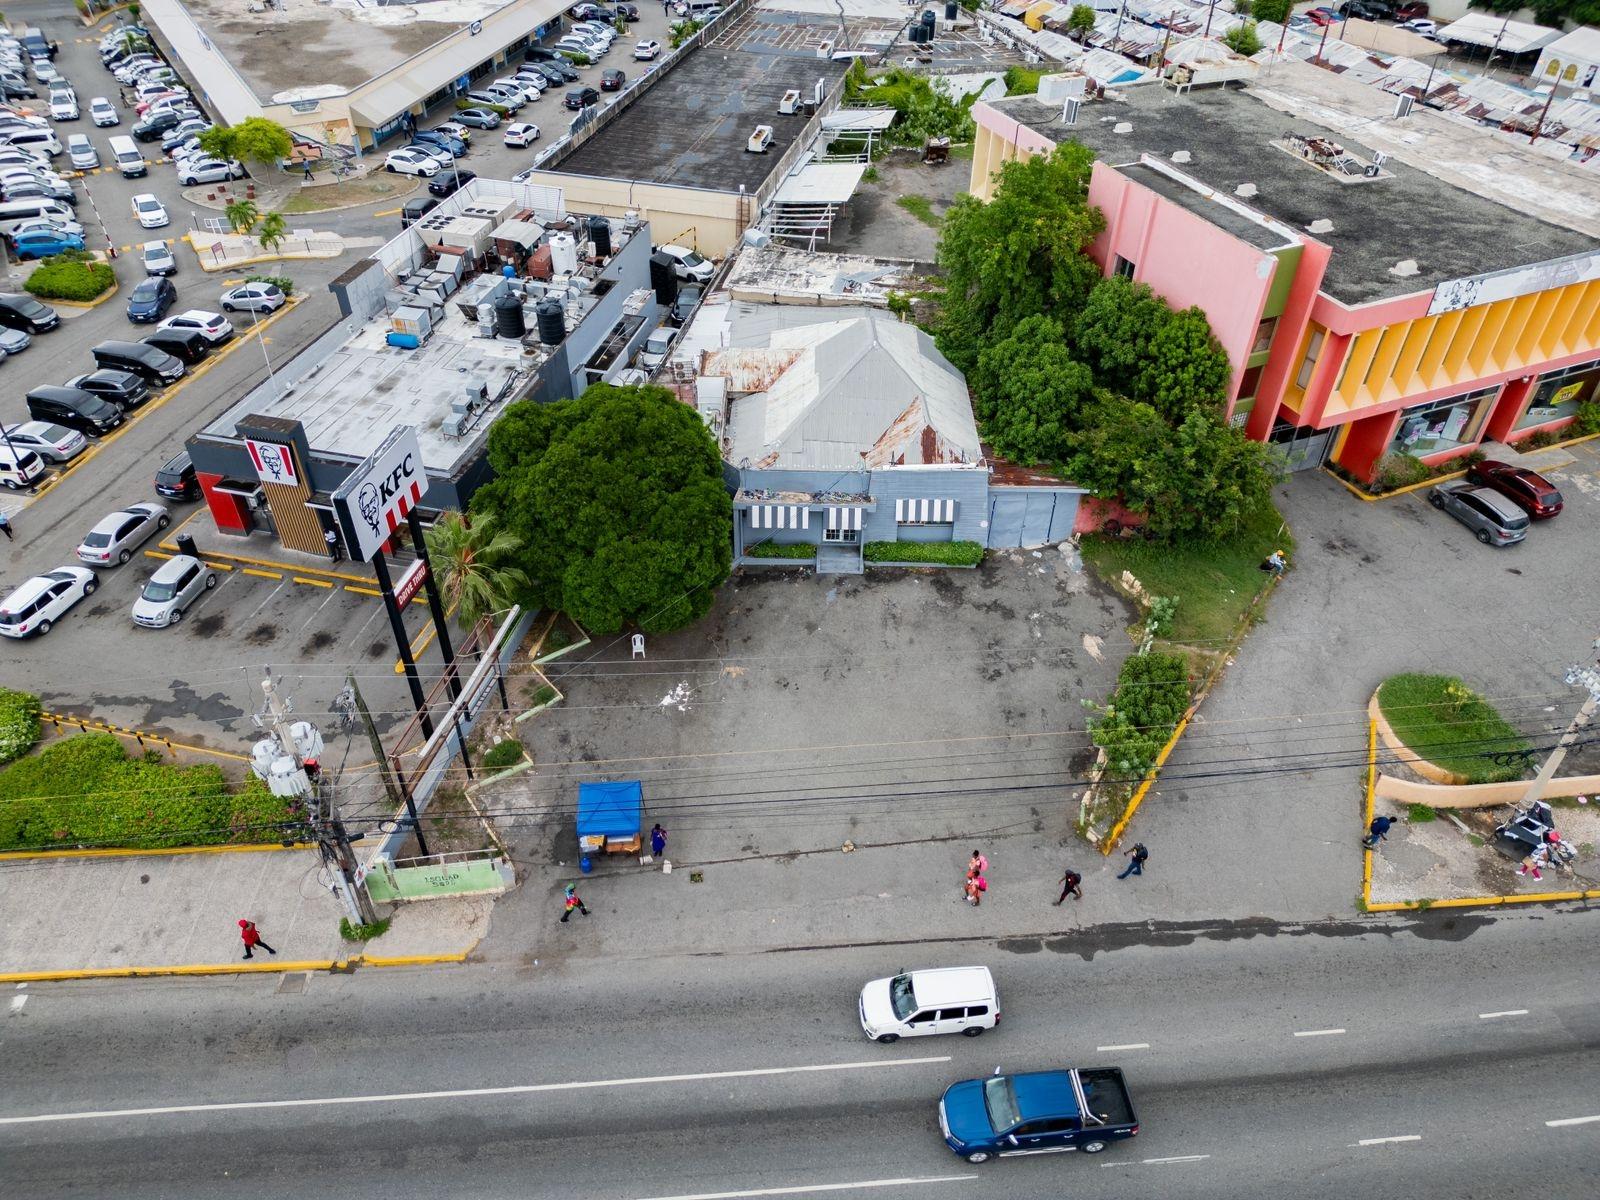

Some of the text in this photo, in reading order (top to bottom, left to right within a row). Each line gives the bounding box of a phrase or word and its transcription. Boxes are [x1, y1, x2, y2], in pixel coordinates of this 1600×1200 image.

[379, 452, 414, 507] KFC
[398, 565, 426, 605] DRIVE THRU
